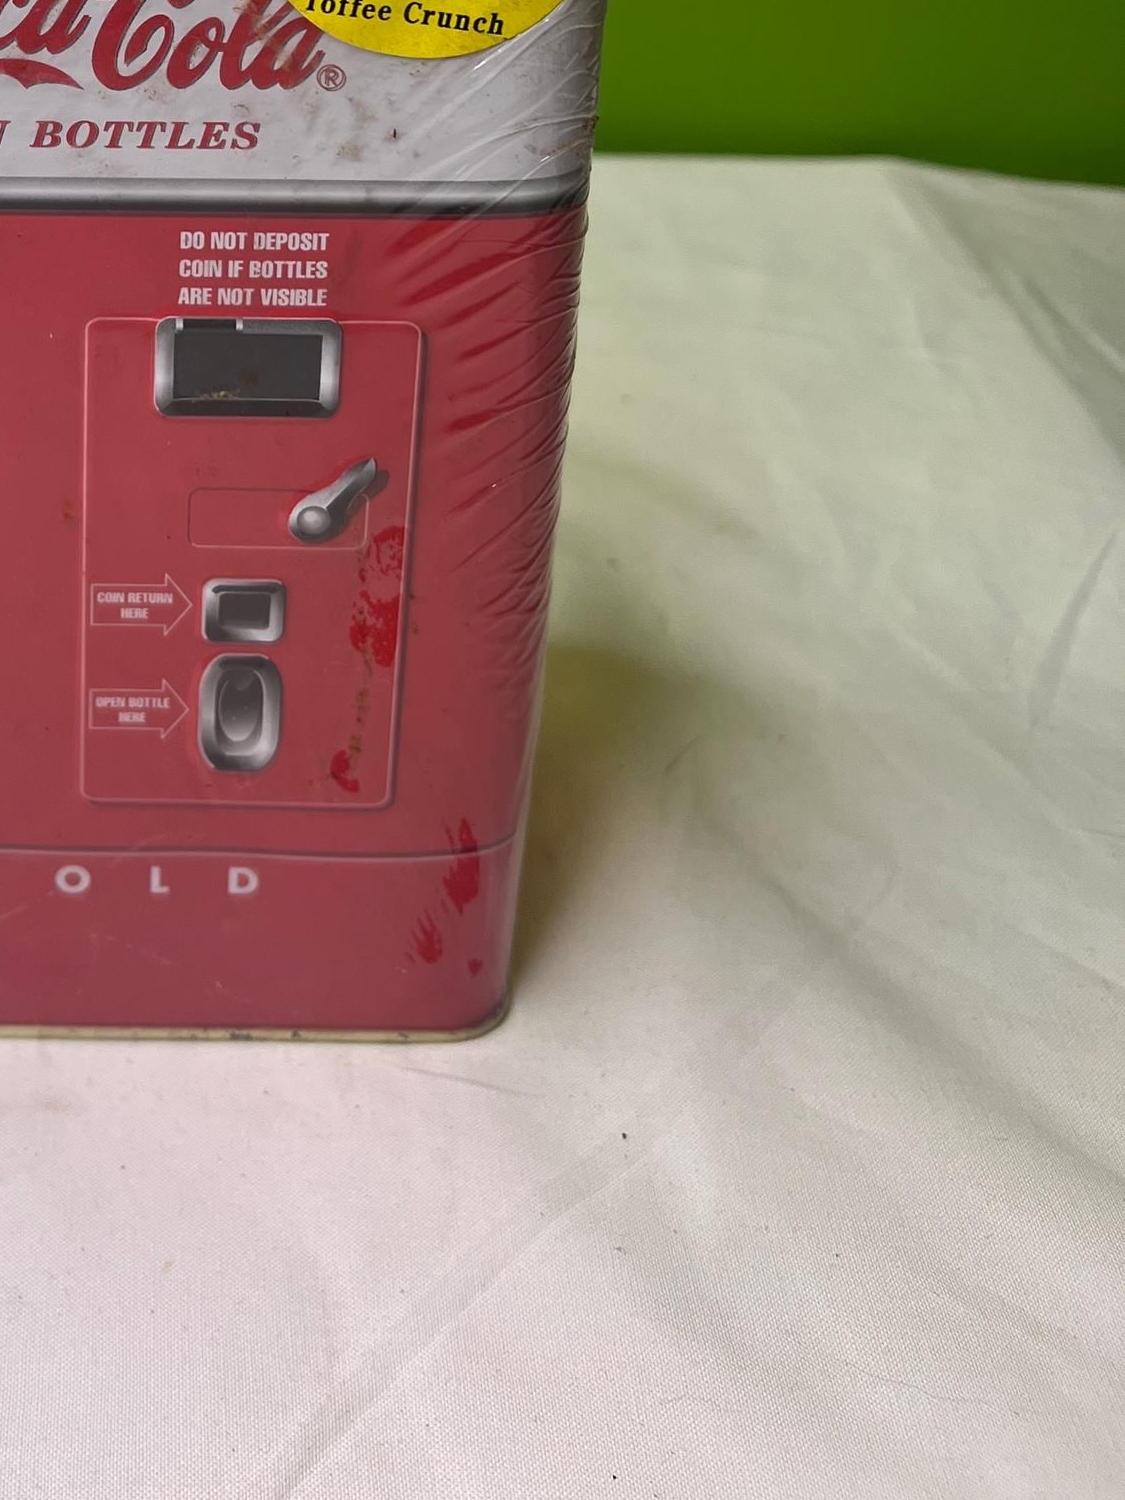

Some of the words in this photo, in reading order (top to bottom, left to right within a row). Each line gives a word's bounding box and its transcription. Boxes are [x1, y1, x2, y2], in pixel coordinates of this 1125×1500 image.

[404, 2, 505, 36] Crunch
[29, 120, 261, 150] BOTTLES
[179, 231, 205, 249] DO
[210, 231, 248, 250] NOT
[253, 232, 330, 251] DEPOSIT
[179, 259, 222, 278] COIN
[228, 259, 244, 278] IF
[249, 260, 328, 279] BOTTLES
[178, 287, 213, 305] ARE
[217, 287, 255, 306] NOT
[260, 288, 328, 306] VISIBLE
[96, 592, 125, 604] COIN
[128, 592, 173, 604] RETURN
[120, 607, 148, 619] HERE
